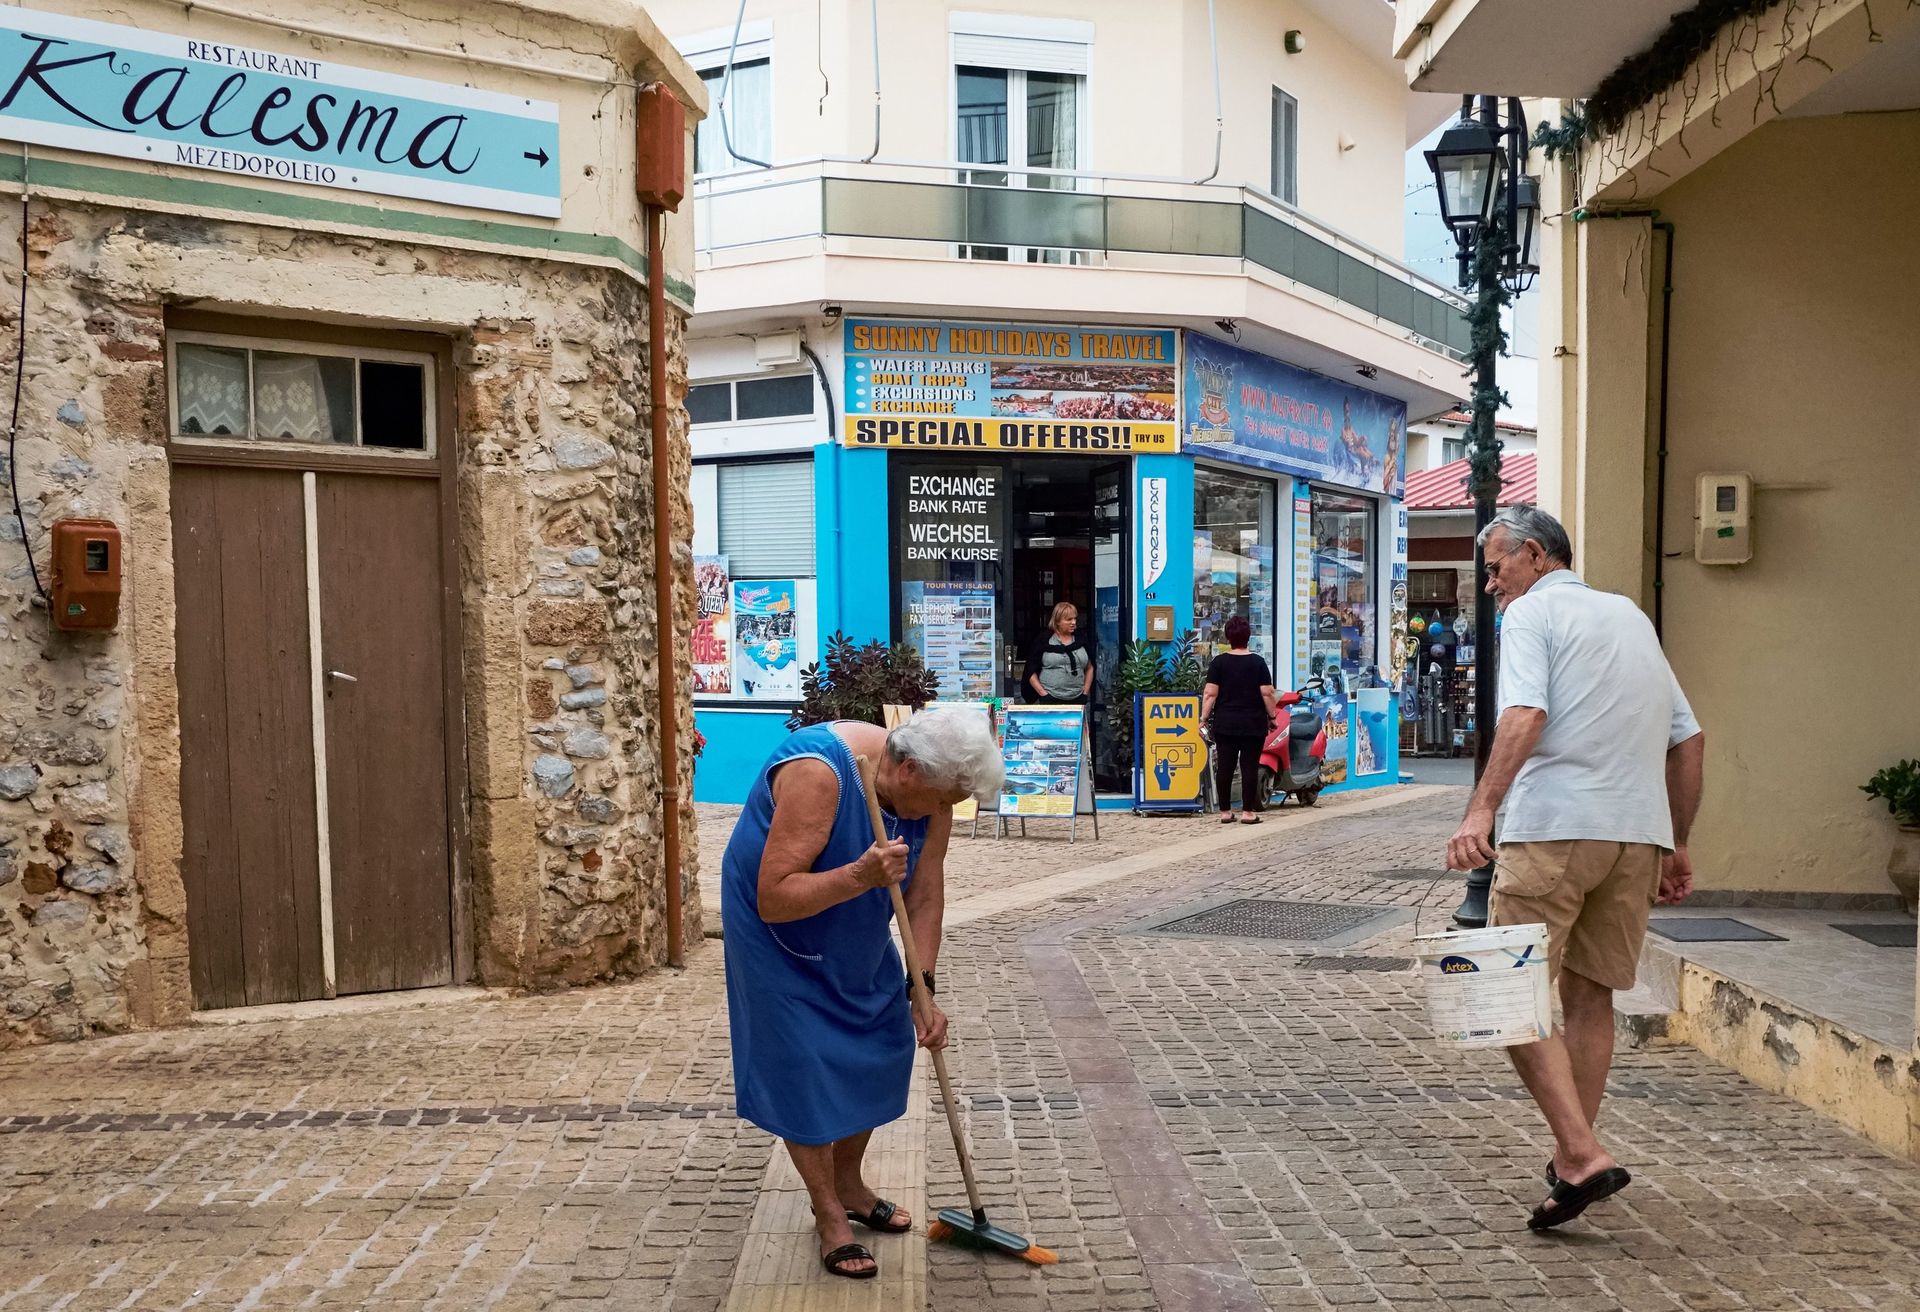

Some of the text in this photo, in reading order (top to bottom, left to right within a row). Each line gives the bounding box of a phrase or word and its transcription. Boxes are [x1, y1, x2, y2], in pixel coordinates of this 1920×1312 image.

[187, 40, 322, 80] RESTAURANT
[0, 32, 481, 176] Kalesma
[175, 143, 337, 184] MEZEDOPOLEIO
[853, 325, 1165, 361] SUNNY HOLIDAYS TRAVEL
[870, 359, 986, 375] WATER PARKS
[870, 374, 968, 387] BOAT TRIPS
[870, 387, 976, 401] EXCURSIONS
[871, 400, 957, 414] EXCHANGE
[856, 419, 1165, 450] SPECIAL OFFERS!! TRY US
[909, 475, 995, 497] EXCHANGE
[909, 499, 987, 514] BANK RATE
[1150, 478, 1159, 570] EXCHANGE
[909, 523, 995, 544] WECHSEL
[907, 547, 998, 561] BANK KURSE
[909, 603, 957, 614] TELEPHONE
[928, 614, 955, 625] SERVICE
[1149, 703, 1193, 719] ATM
[1445, 962, 1475, 973] Artex
